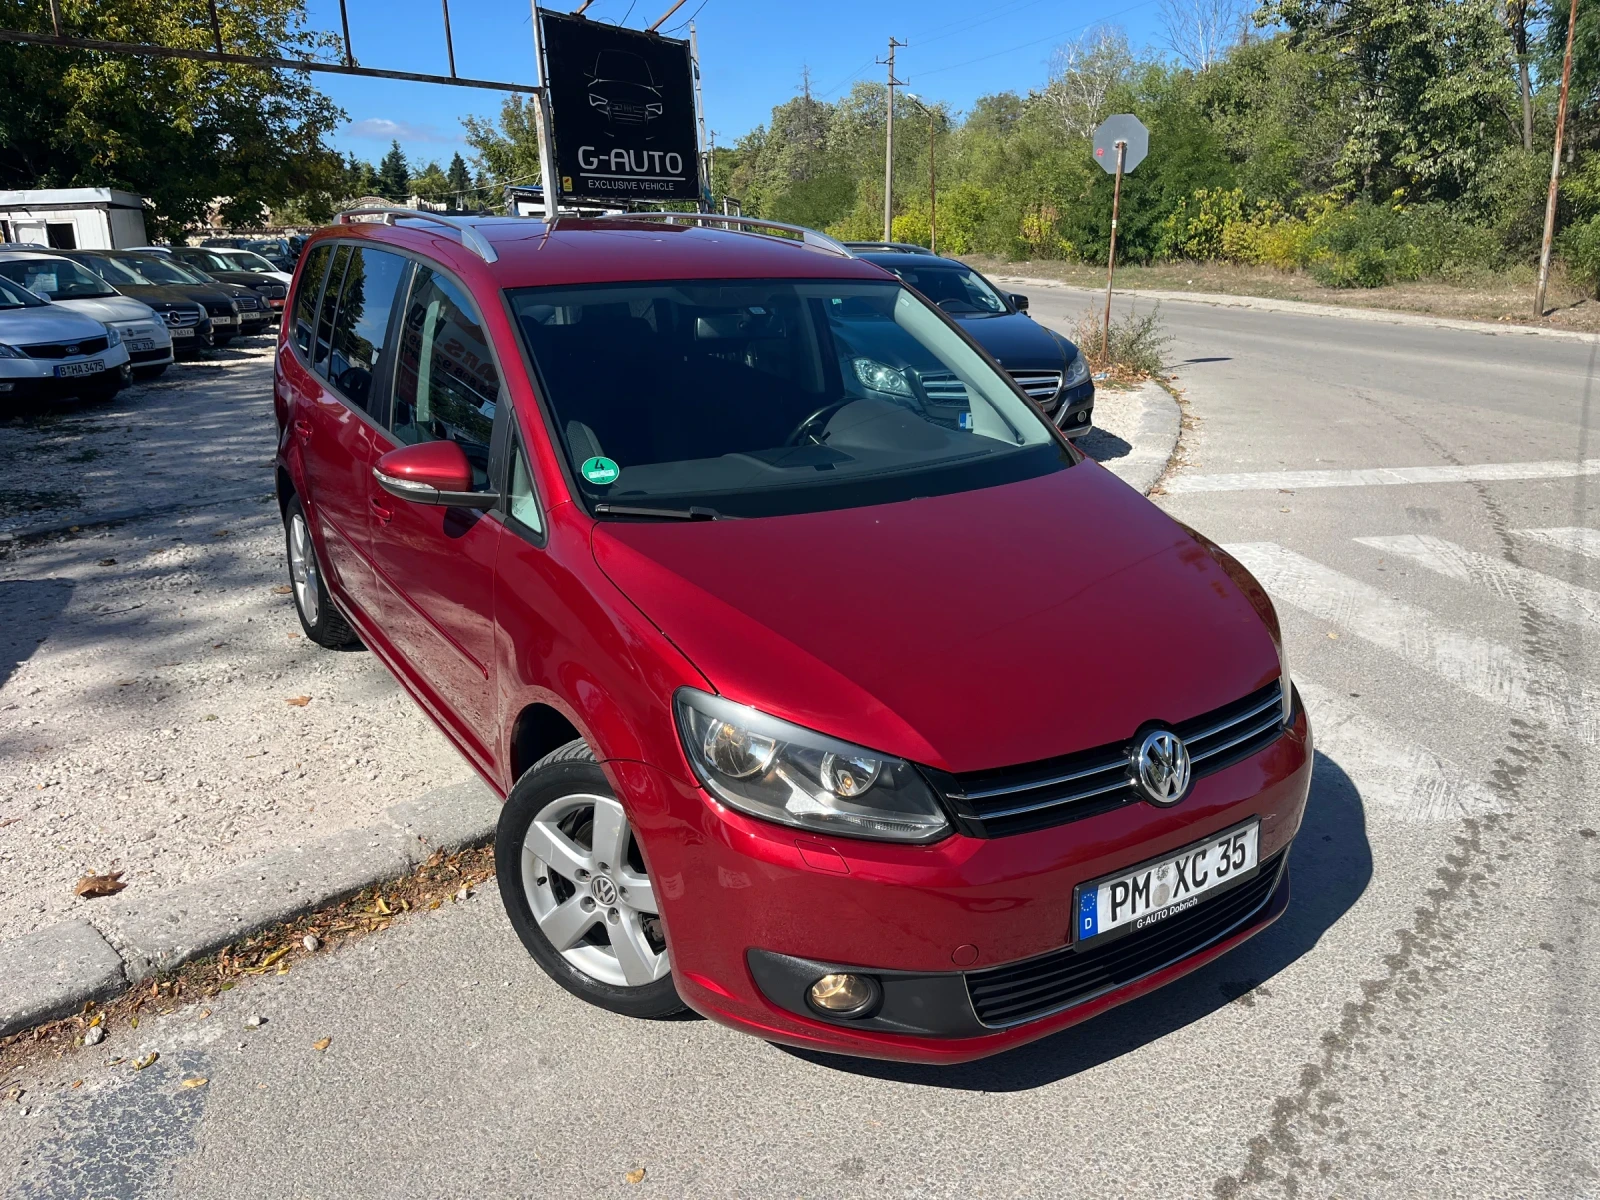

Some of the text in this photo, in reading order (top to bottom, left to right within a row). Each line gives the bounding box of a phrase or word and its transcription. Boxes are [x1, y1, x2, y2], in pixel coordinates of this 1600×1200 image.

[577, 145, 683, 174] G-AUTO
[588, 179, 674, 191] EXCLUSIVE VEHICLE
[60, 367, 67, 376] B
[71, 365, 82, 374] HA
[84, 361, 104, 373] 3475
[594, 459, 605, 470] 4
[1109, 830, 1248, 922] PM XC 35
[1136, 896, 1198, 929] G-AUTO Dobrich
[1084, 917, 1092, 930] D
